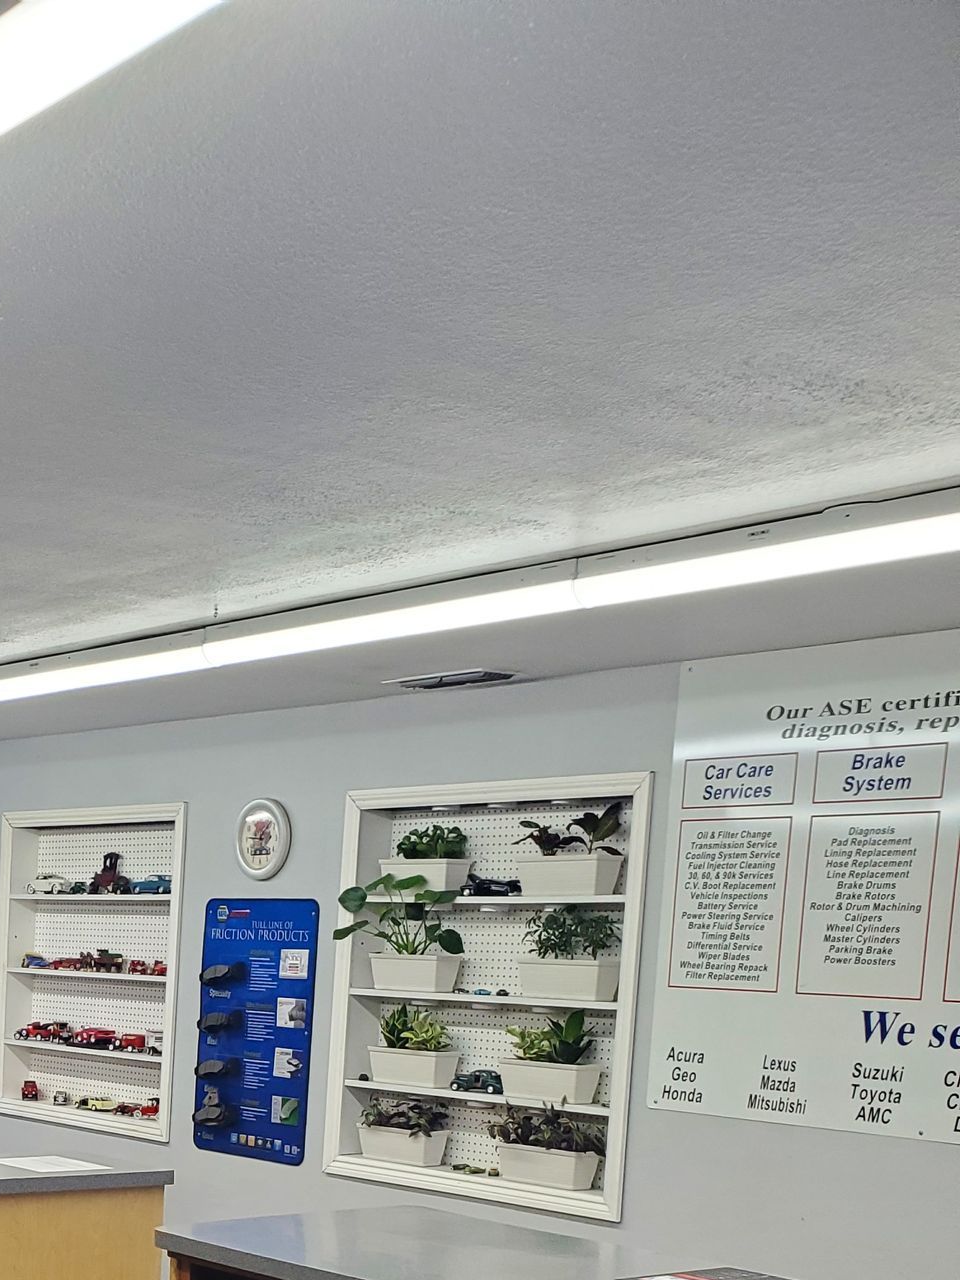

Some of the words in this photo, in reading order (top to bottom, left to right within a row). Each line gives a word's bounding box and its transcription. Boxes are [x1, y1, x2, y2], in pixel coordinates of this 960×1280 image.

[766, 705, 813, 721] Our
[818, 698, 872, 717] ASE
[782, 717, 905, 740] diagnosis,
[914, 716, 959, 733] rep
[851, 752, 905, 770] Brake
[705, 765, 732, 780] Car
[736, 763, 774, 778] Care
[842, 775, 911, 796] System
[703, 784, 772, 800] Services
[717, 831, 739, 839] Filter
[740, 831, 772, 840] Change
[848, 826, 895, 837] Diagnosis
[691, 841, 744, 849] Transmission
[746, 840, 777, 849] Service
[831, 838, 848, 846] Pad
[850, 837, 912, 847] Replacement
[685, 852, 716, 861] Cooling
[718, 851, 747, 860] System
[749, 851, 781, 859] Service
[824, 849, 852, 859] Lining
[855, 849, 917, 858] Replacement
[707, 862, 737, 871] Injector
[740, 861, 776, 871] Cleaning
[826, 860, 849, 868] Hose
[851, 859, 912, 869] Replacement
[688, 872, 699, 880] 30,
[702, 872, 712, 880] 60,
[826, 870, 846, 879] Line
[848, 870, 909, 880] Replacement
[723, 882, 776, 890] Replacement
[837, 881, 864, 890] Brake
[866, 881, 896, 890] Drums
[691, 892, 719, 900] Vehicle
[721, 892, 768, 901] Inspections
[835, 892, 861, 900] Brake
[864, 892, 896, 900] Rotors
[697, 902, 726, 911] Battery
[728, 902, 758, 910] Service
[810, 902, 835, 910] Rotor
[837, 902, 843, 911] &
[845, 903, 870, 911] Drum
[873, 903, 921, 913] Machining
[707, 912, 741, 922] Steering
[743, 912, 773, 920] Service
[845, 913, 882, 923] Calipers
[269, 921, 283, 929] LINE
[284, 921, 294, 929] OF
[712, 922, 732, 930] Fluid
[734, 922, 765, 931] Service
[826, 924, 854, 932] Wheel
[856, 924, 900, 934] Cylinders
[212, 929, 254, 940] FRICTION
[259, 930, 309, 941] PRODUCTS
[701, 932, 727, 942] Timing
[730, 932, 750, 941] Belts
[823, 934, 854, 943] Master
[856, 935, 900, 945] Cylinders
[687, 942, 730, 950] Differential
[733, 943, 763, 951] Service
[829, 945, 863, 955] Parking
[866, 946, 893, 955] Brake
[698, 952, 721, 960] Wiper
[723, 952, 750, 961] Blades
[824, 955, 852, 964] Power
[854, 956, 896, 966] Boosters
[680, 961, 703, 969] Wheel
[705, 962, 735, 972] Bearing
[738, 963, 768, 972] Repack
[685, 971, 706, 979] Filter
[707, 972, 759, 981] Replacement
[862, 1010, 915, 1046] We
[666, 1046, 704, 1064] Acura
[762, 1054, 796, 1072] Lexus
[672, 1066, 696, 1083] Geo
[852, 1062, 904, 1082] Suzuki
[760, 1075, 796, 1093] Mazda
[662, 1085, 702, 1103] Honda
[851, 1084, 902, 1105] Toyota
[748, 1094, 806, 1115] Mitsubishi
[856, 1106, 892, 1124] AMC
